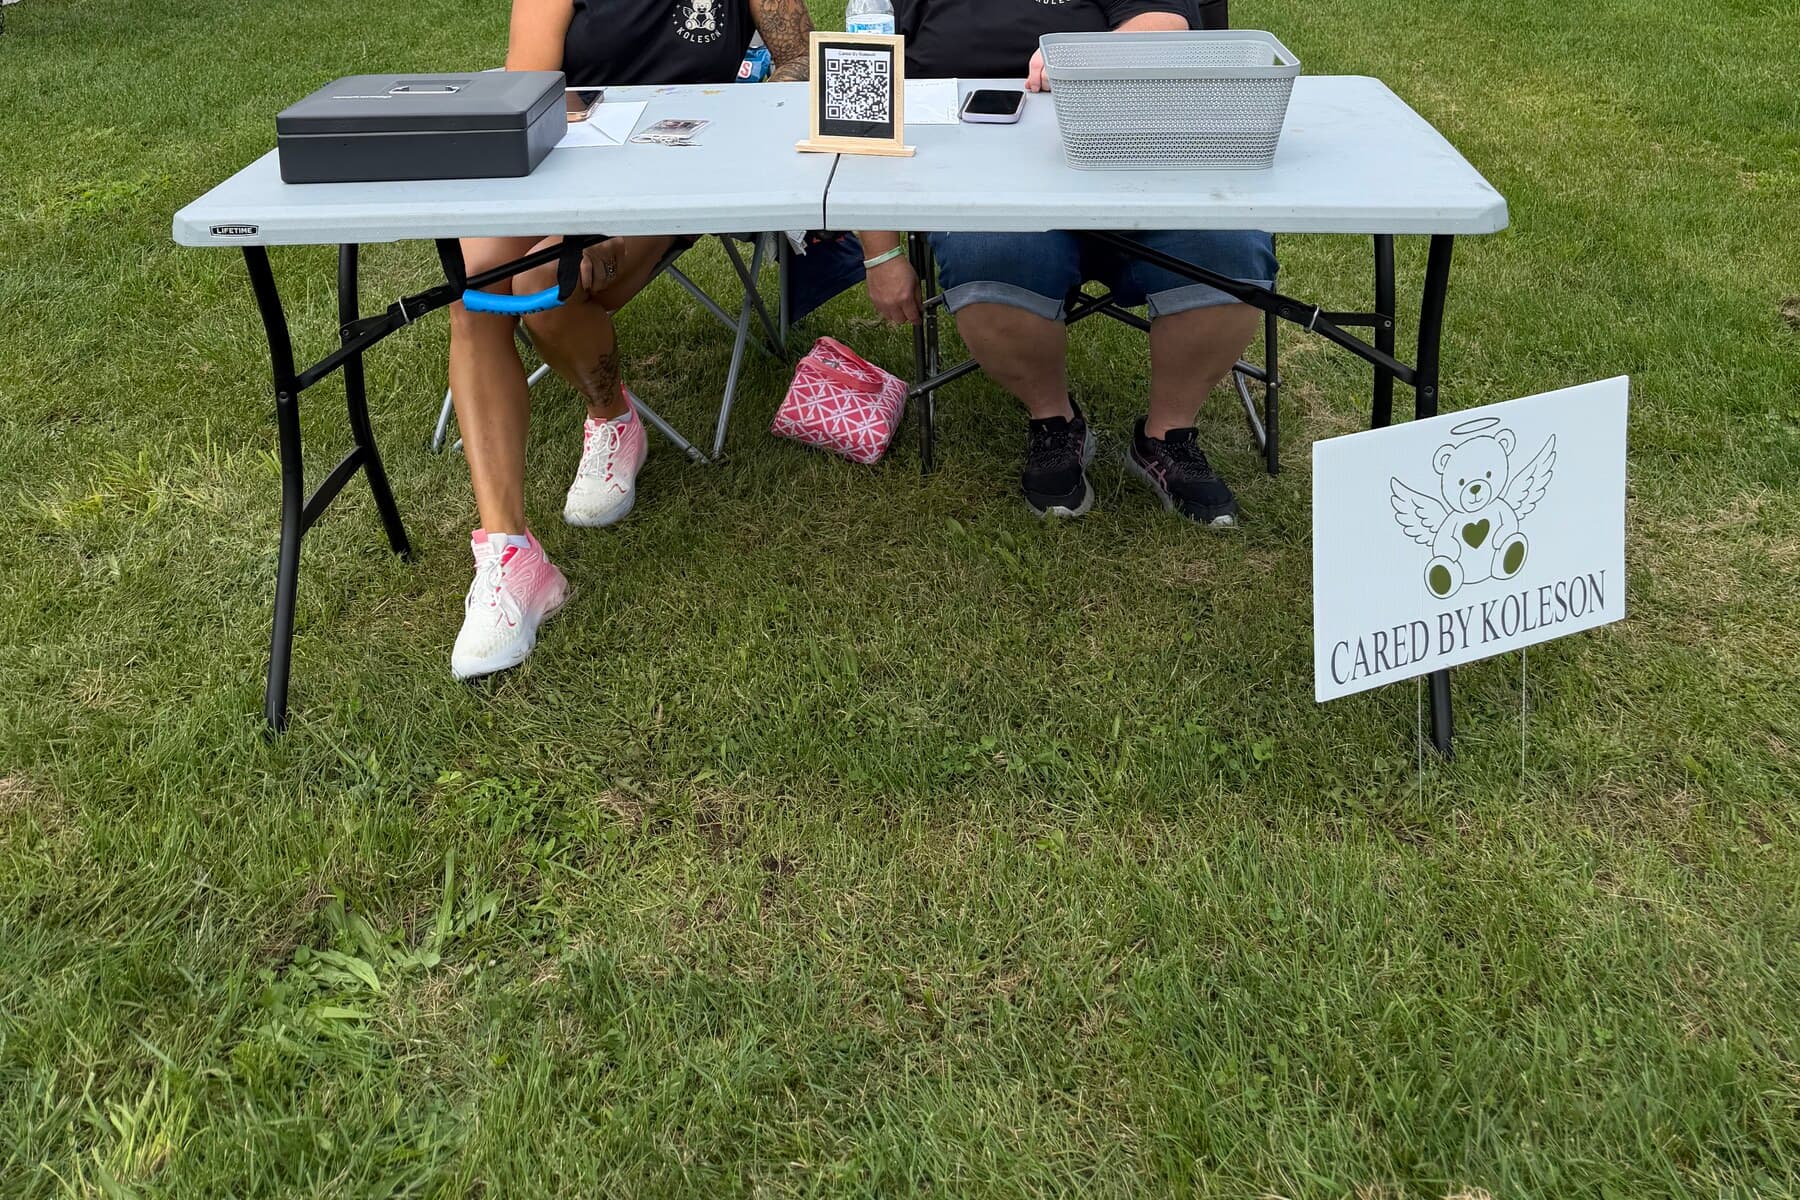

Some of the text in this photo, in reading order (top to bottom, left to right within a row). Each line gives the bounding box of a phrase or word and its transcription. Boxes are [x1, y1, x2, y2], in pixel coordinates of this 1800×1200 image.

[676, 26, 722, 43] KOLESON
[1330, 570, 1606, 685] CARED BY KOLESON
